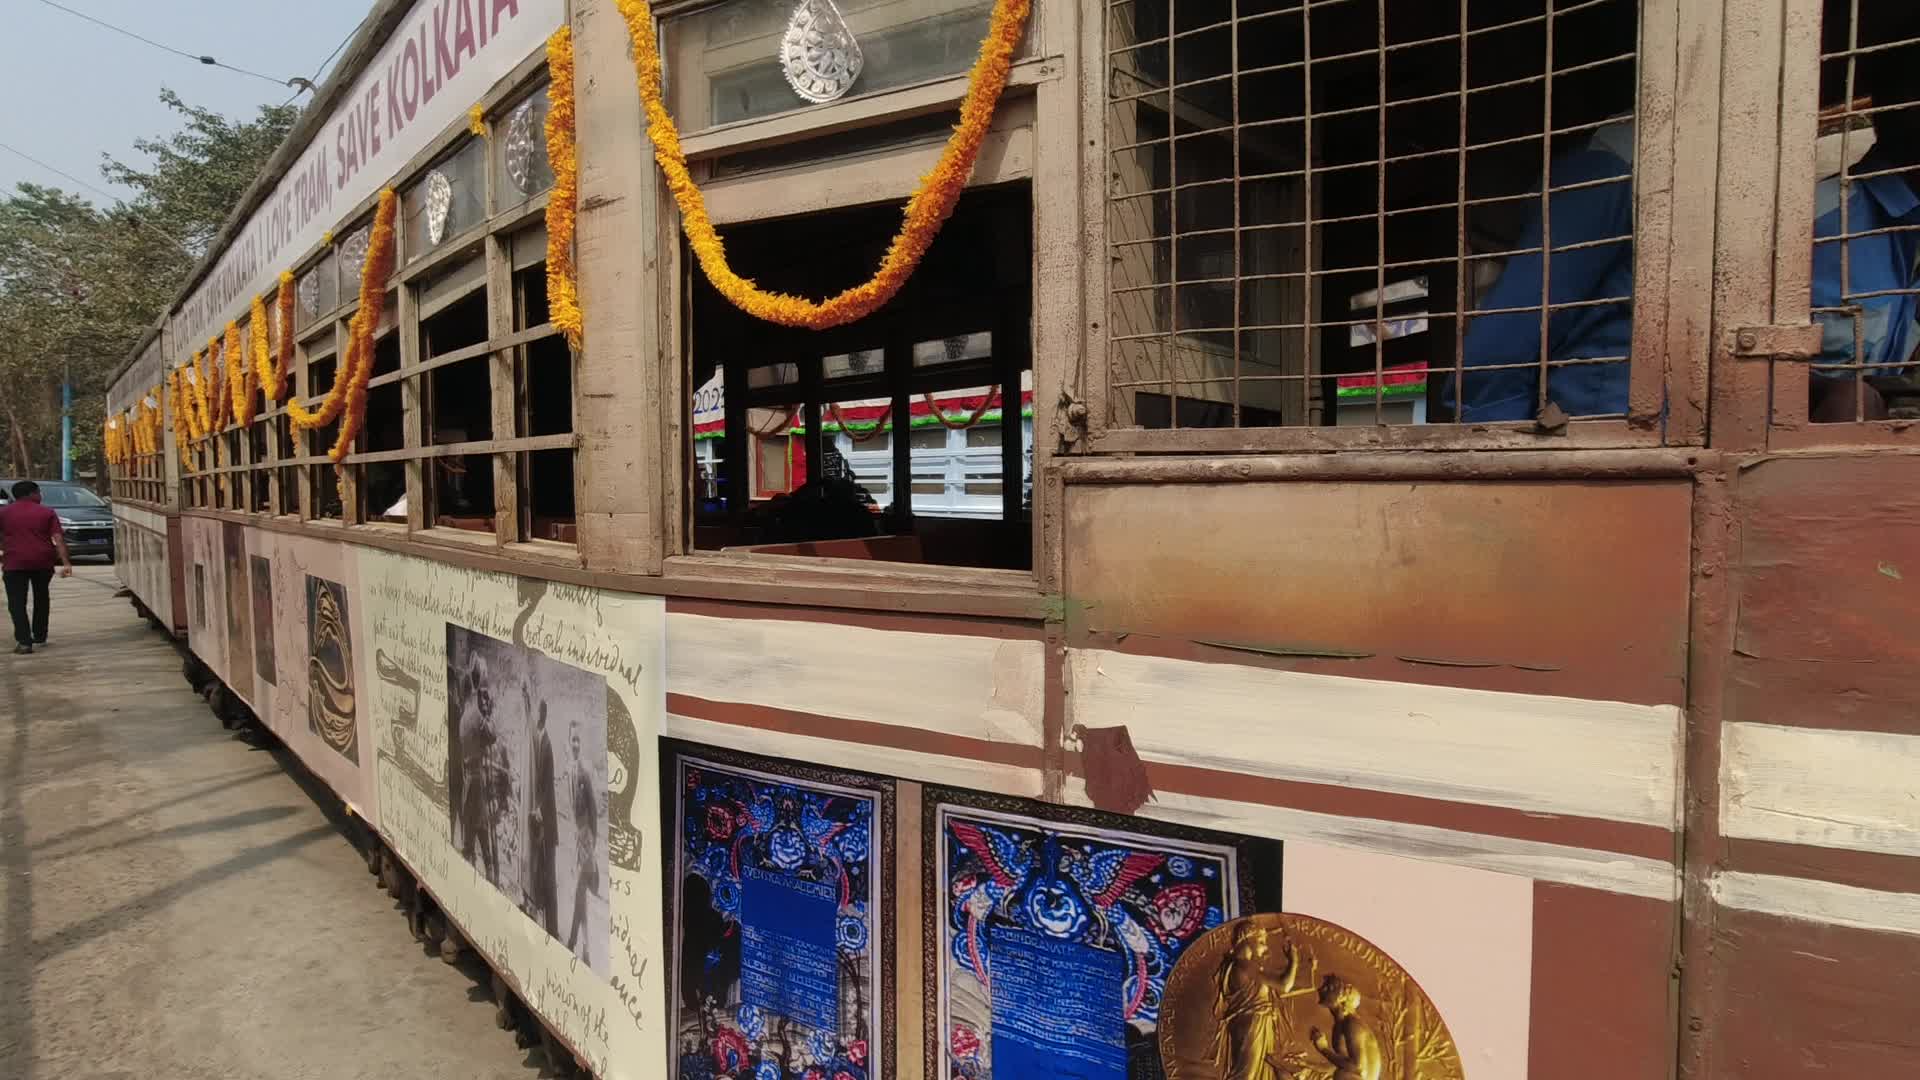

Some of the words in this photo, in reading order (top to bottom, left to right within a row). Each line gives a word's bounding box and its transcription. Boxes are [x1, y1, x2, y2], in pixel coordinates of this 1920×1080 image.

[266, 192, 292, 264] LOVE
[295, 145, 332, 232] TRAM,
[336, 80, 382, 190] SAVE
